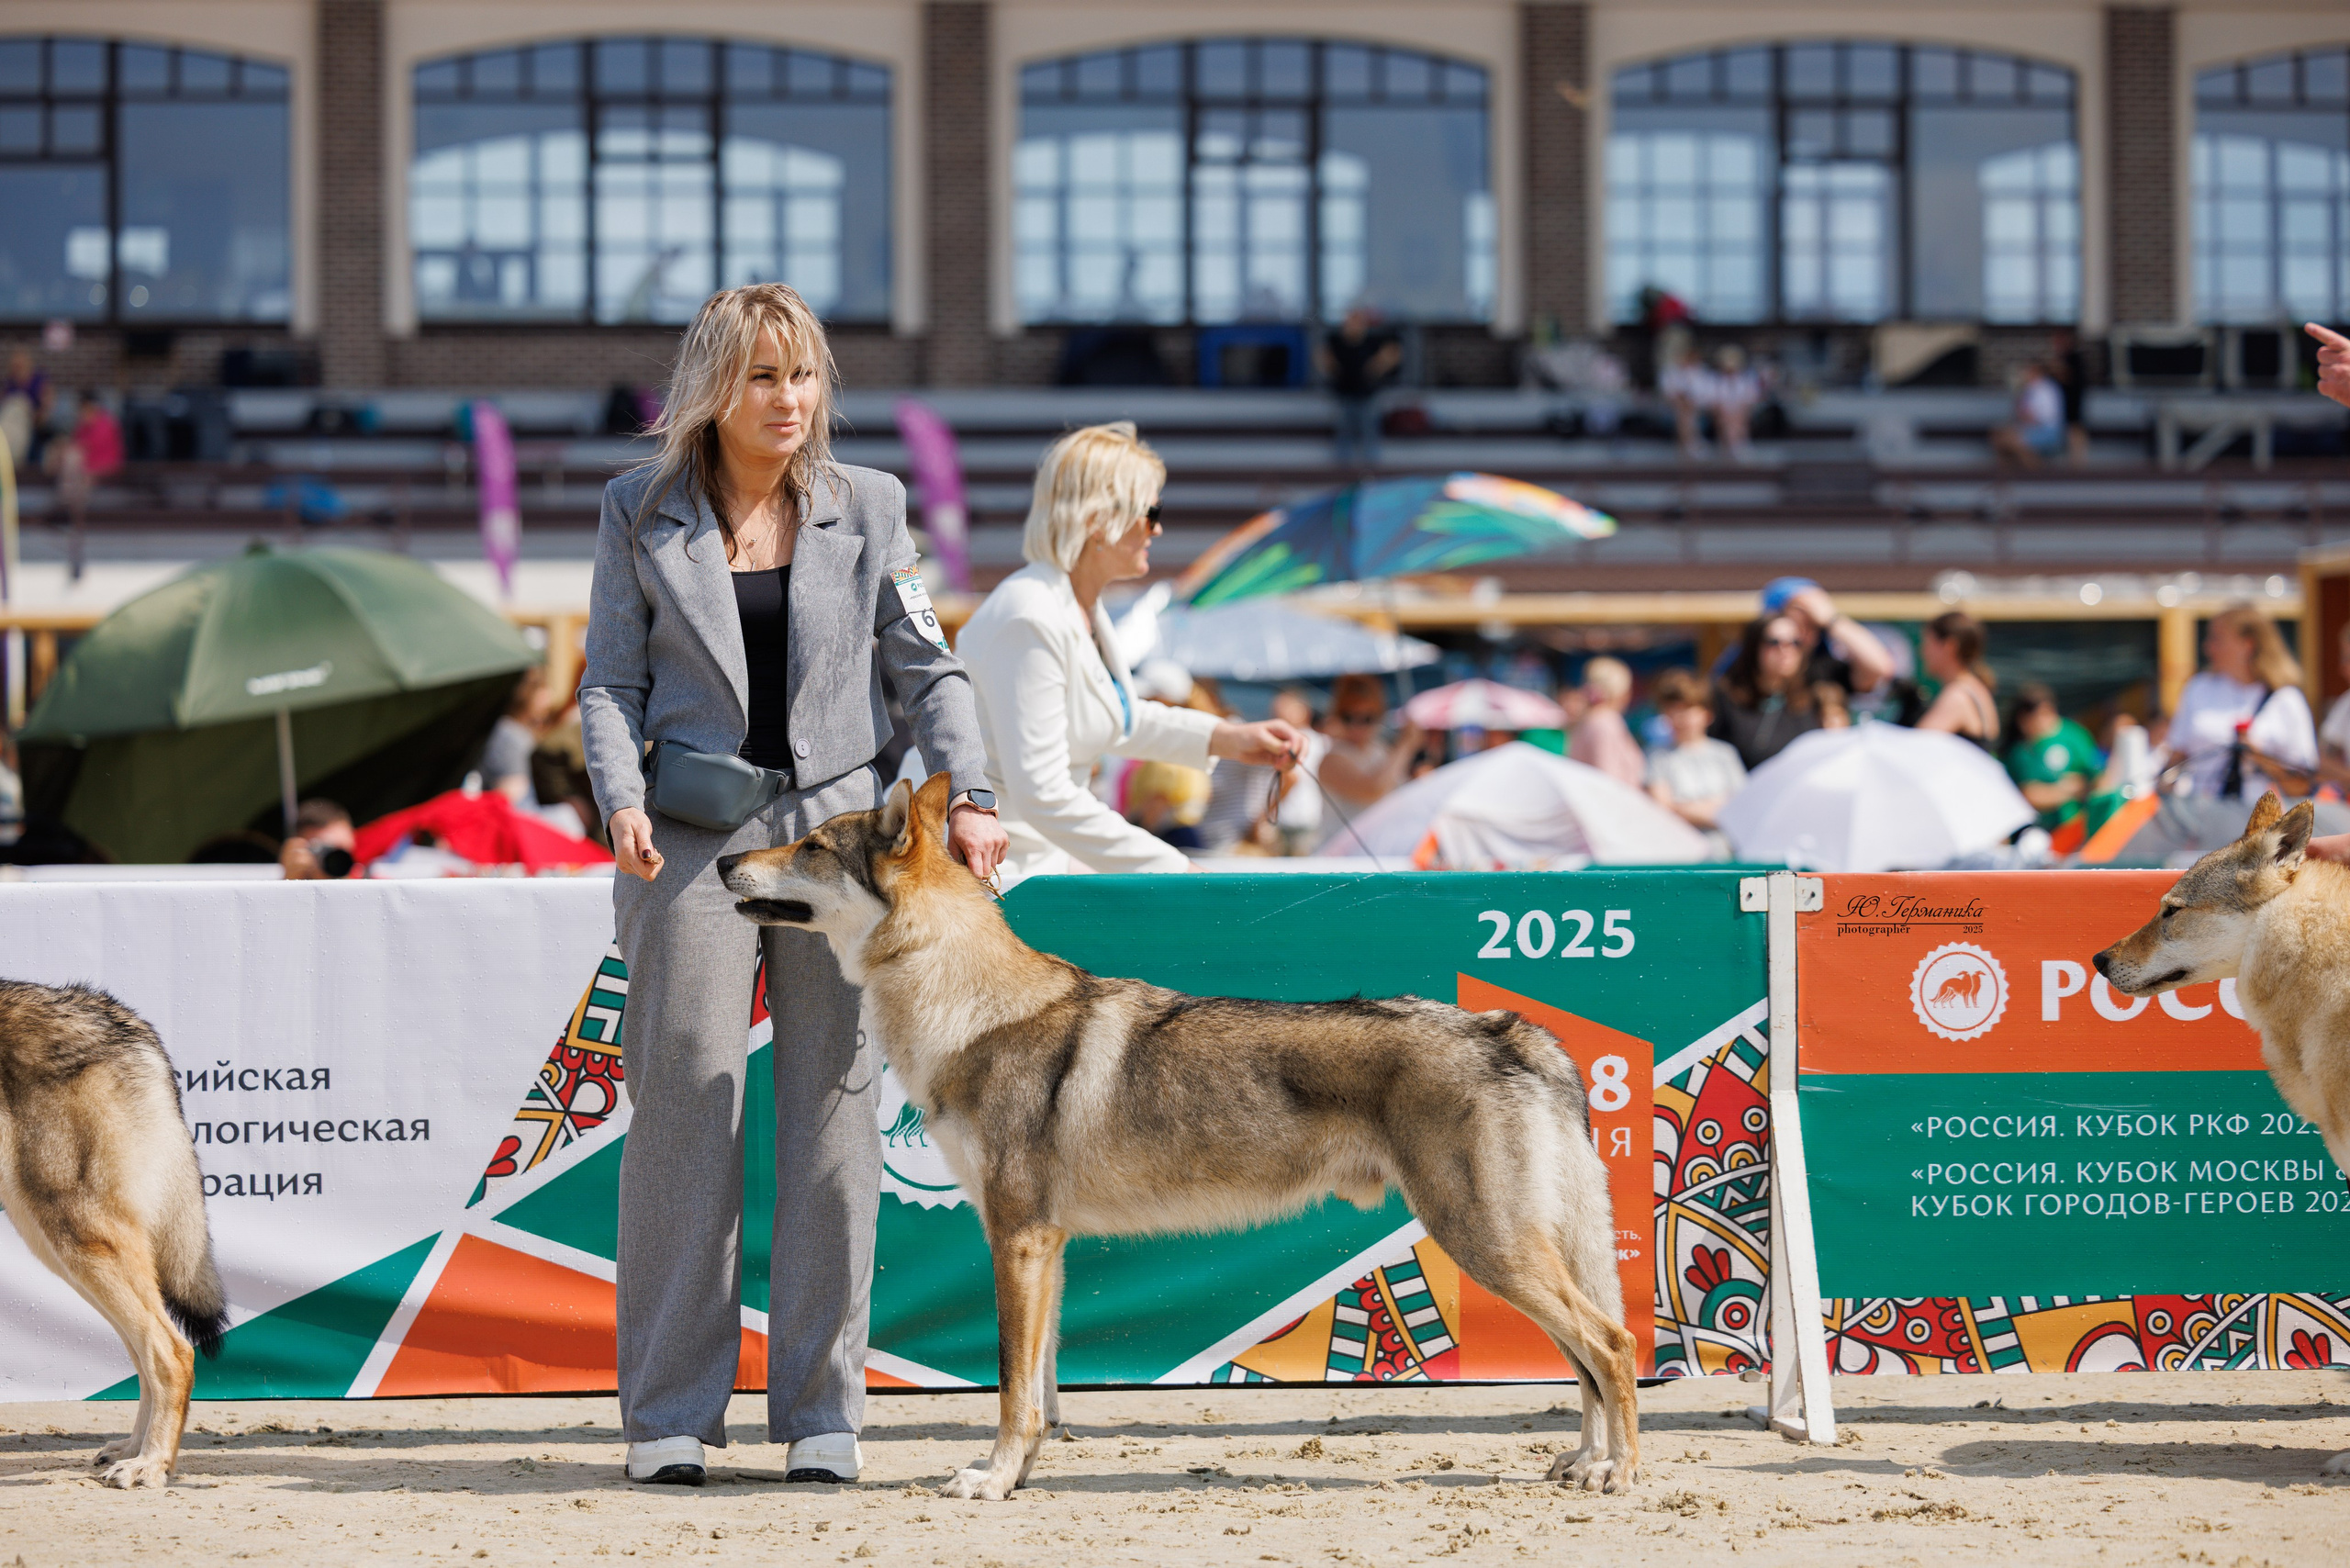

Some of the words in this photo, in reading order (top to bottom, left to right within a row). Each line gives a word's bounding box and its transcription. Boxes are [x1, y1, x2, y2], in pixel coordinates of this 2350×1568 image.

[1477, 909, 1636, 959] 2025
[1589, 1055, 1631, 1113] 8
[1911, 1115, 2065, 1138] «РОССИЯ.
[2076, 1114, 2178, 1137] КУБОК
[2189, 1114, 2250, 1136] РКФ
[2261, 1113, 2323, 1135] 202
[1911, 1162, 2065, 1185] «РОССИЯ.
[2076, 1160, 2178, 1183] КУБОК
[2189, 1159, 2323, 1182] МОСКВЫ
[1911, 1193, 2014, 1217] КУБОК
[2025, 1192, 2294, 1220] ГОРОДОВ-ГЕРОЕВ
